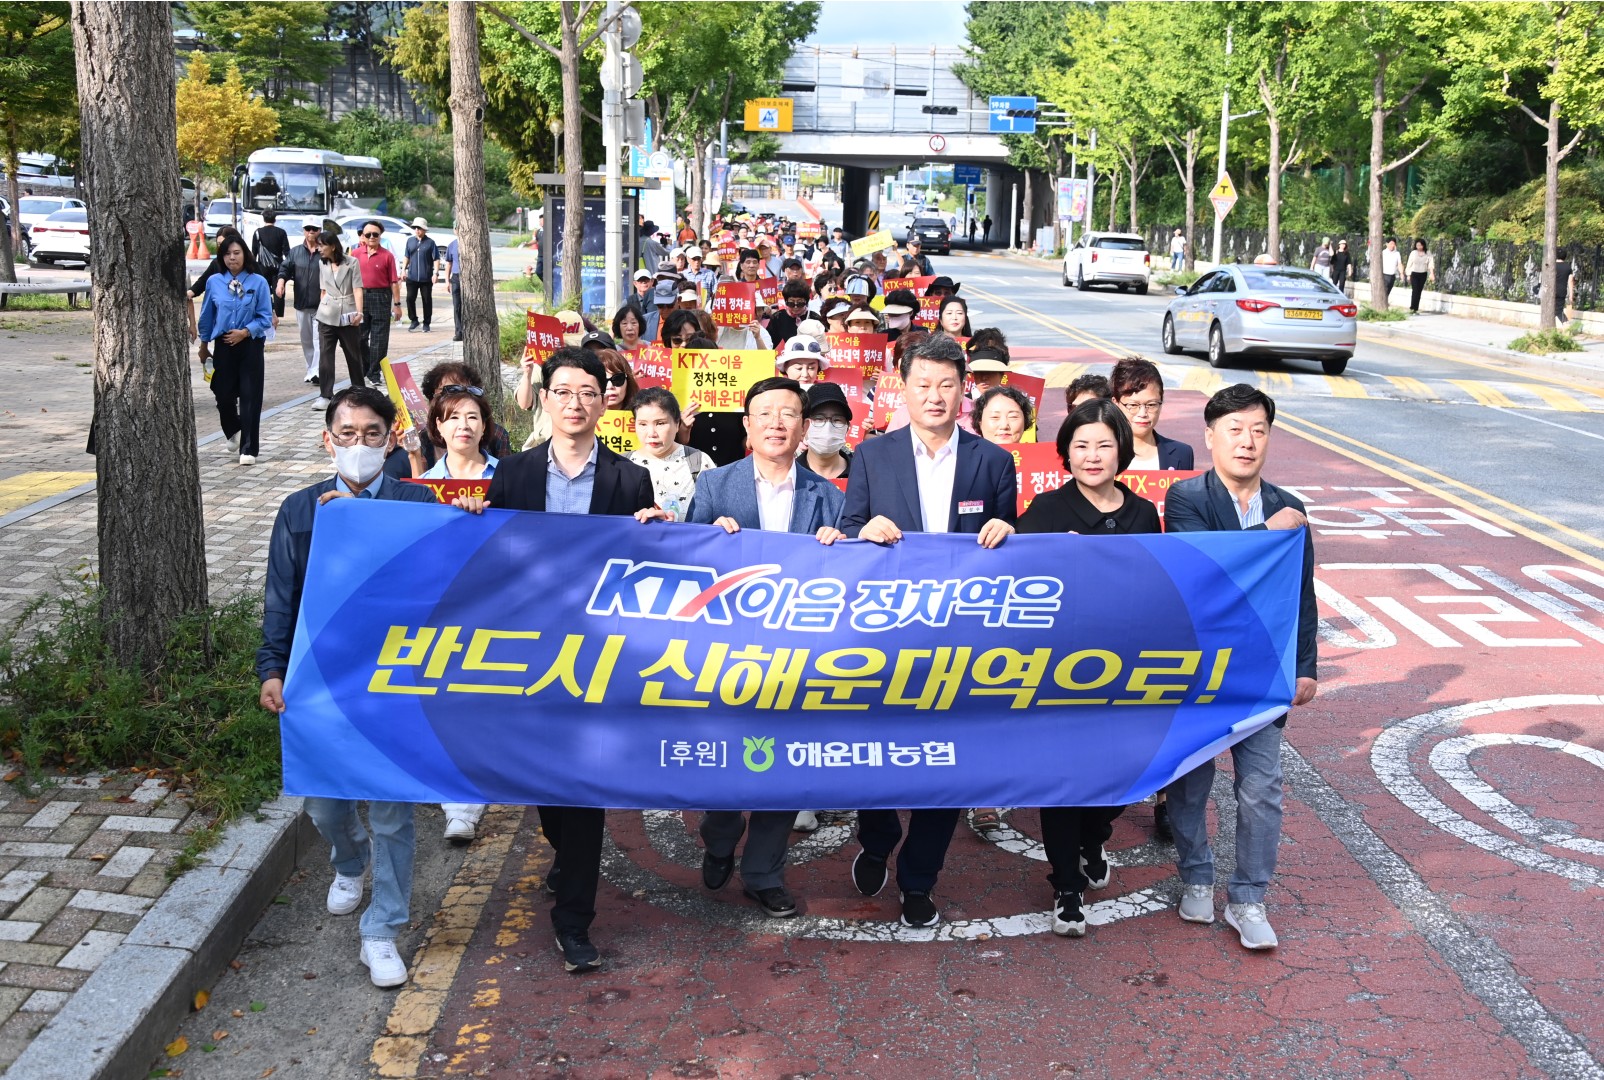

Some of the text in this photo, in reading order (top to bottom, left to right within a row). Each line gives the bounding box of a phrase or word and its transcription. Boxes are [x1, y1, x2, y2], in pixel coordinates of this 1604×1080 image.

[729, 298, 752, 311] 정차로
[726, 313, 753, 324] 발전을!
[539, 332, 561, 348] 정차로
[678, 352, 743, 369] KTX-이음
[864, 349, 883, 362] 정차로
[693, 371, 738, 387] 정차역은
[690, 389, 745, 407] 신해운대
[849, 575, 1064, 633] 정차역은
[367, 625, 1233, 711] 반드시 신해운대역으로!
[660, 740, 727, 768] [후원]
